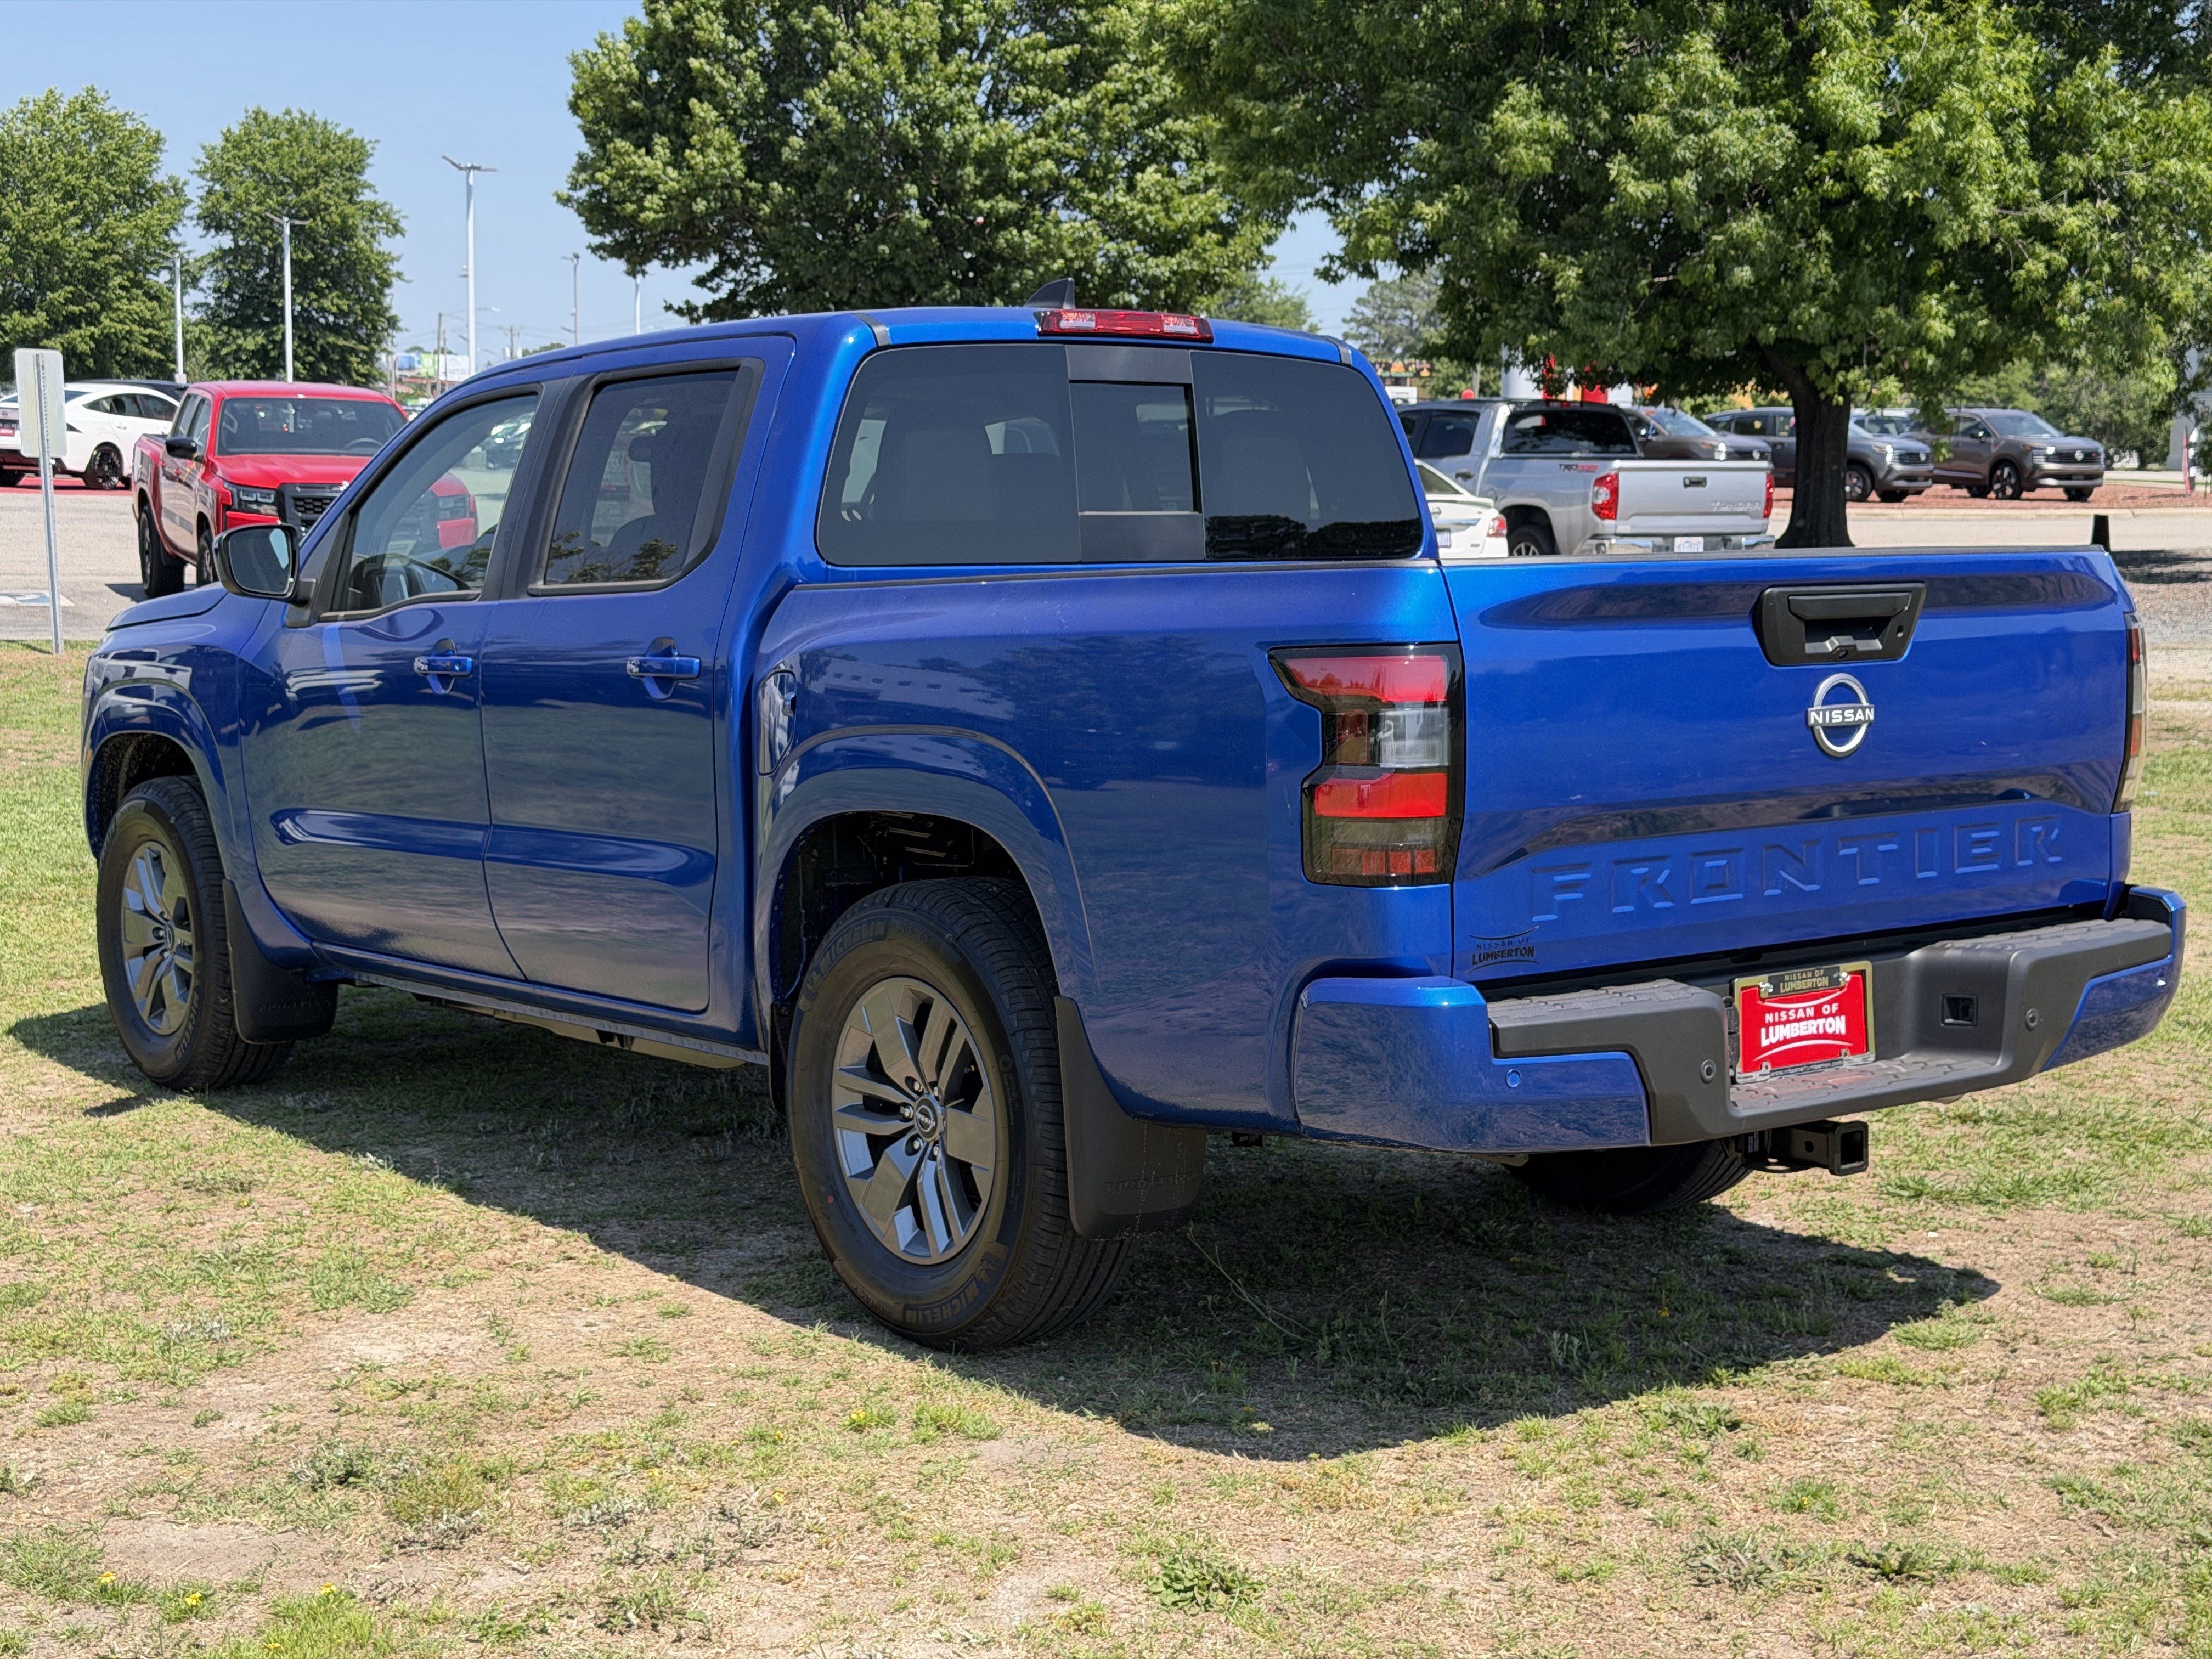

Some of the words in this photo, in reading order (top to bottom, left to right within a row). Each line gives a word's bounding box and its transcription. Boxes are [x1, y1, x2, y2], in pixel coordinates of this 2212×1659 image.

[1810, 708, 1874, 724] NISSAN
[1532, 814, 2062, 921] FRONTIER
[819, 921, 885, 975] MICHELIN
[1476, 940, 1513, 950] NISSAN
[1472, 946, 1535, 966] LUMBERTON
[1780, 977, 1829, 993] LUMBERTON
[1784, 972, 1812, 981] NISSAN
[1765, 1007, 1814, 1024] NISSAN
[1822, 1003, 1839, 1015] OF
[1760, 1015, 1846, 1048] LUMBERTON
[906, 1279, 980, 1324] MICHELIN
